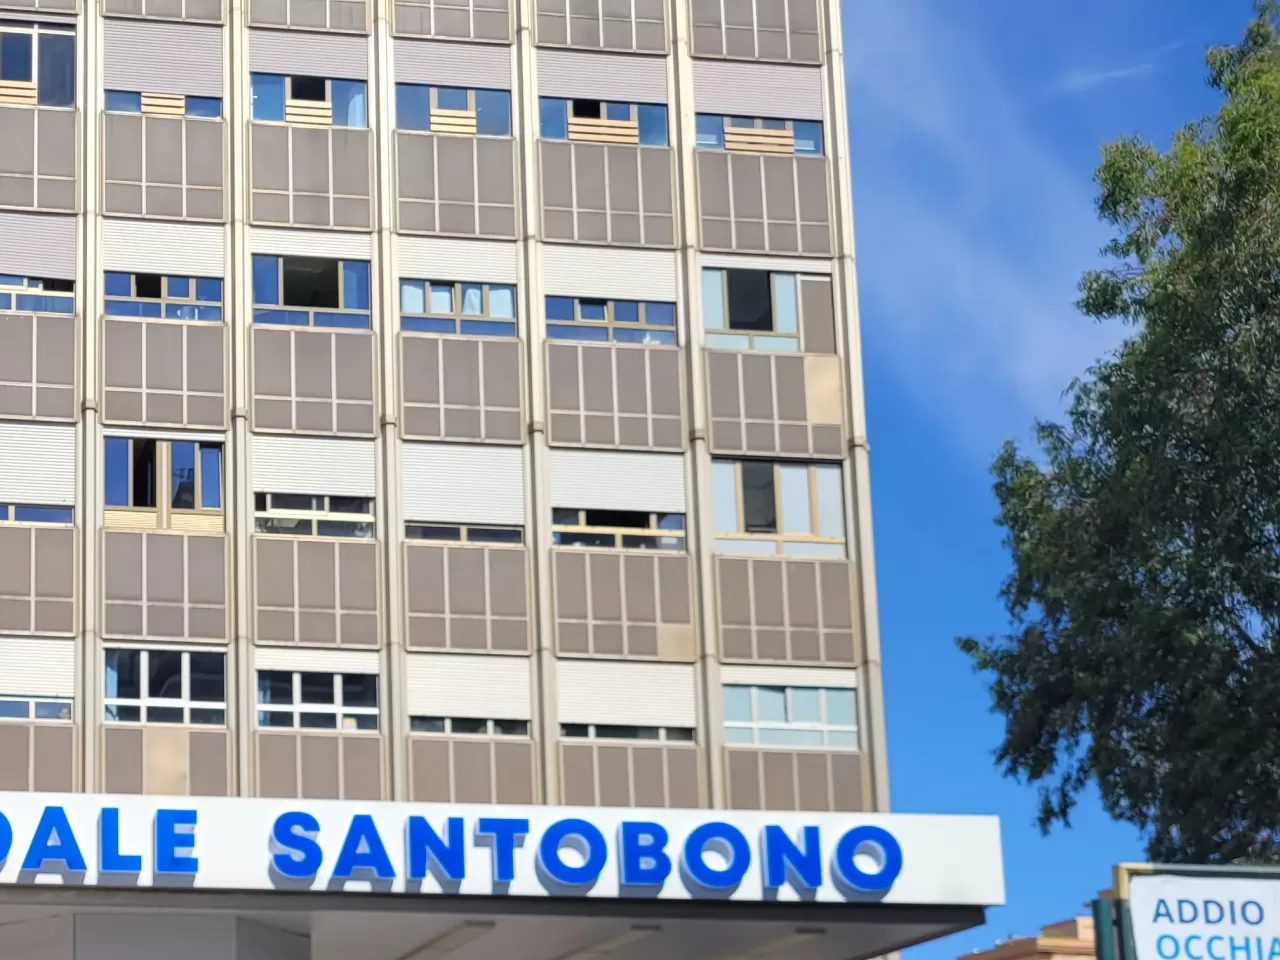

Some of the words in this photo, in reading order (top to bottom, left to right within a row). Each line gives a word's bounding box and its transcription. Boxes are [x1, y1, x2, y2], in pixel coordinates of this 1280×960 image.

[271, 811, 903, 891] SANTOBONO
[1152, 899, 1264, 925] ADDIO
[1156, 934, 1280, 960] OCCHIA
